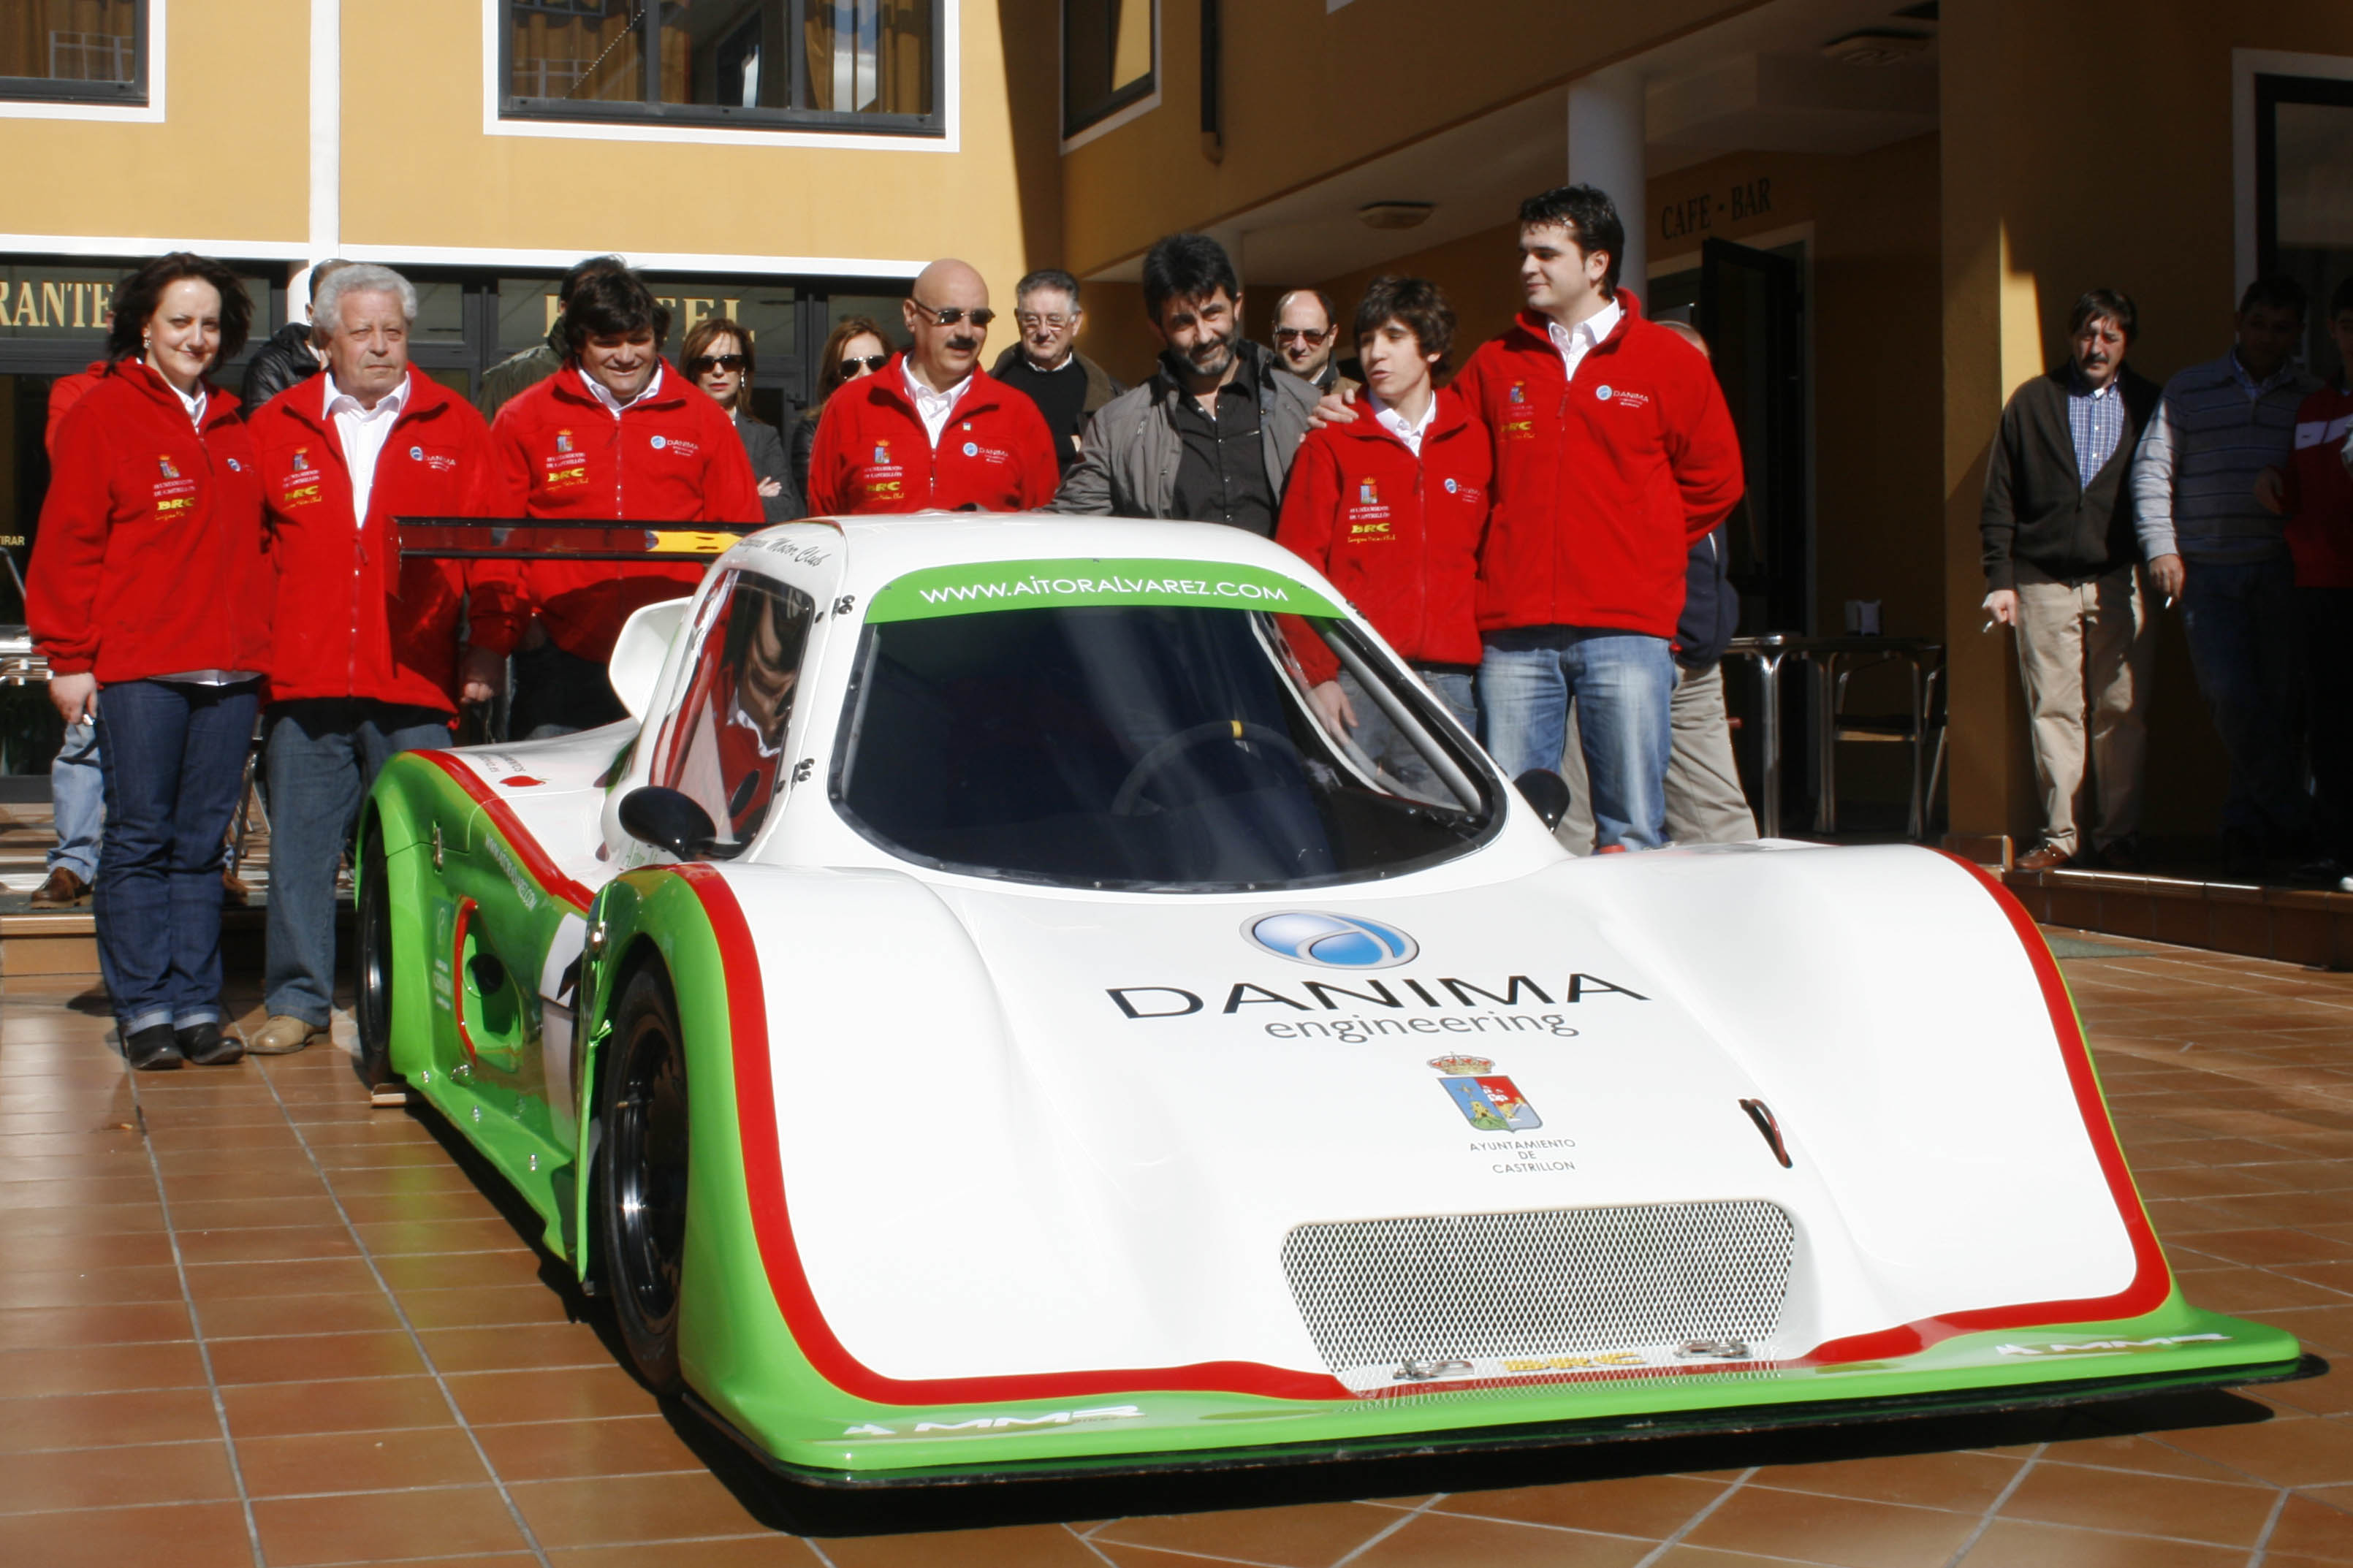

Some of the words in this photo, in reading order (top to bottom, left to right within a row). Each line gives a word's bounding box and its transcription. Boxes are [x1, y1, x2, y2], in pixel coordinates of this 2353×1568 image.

[1662, 194, 1711, 240] CAFE
[1730, 178, 1772, 222] BAR
[547, 468, 585, 482] BRC
[156, 497, 195, 511] BRC
[1350, 522, 1391, 534] BRC
[794, 546, 832, 567] Club
[1105, 973, 1653, 1019] DANIMA
[1264, 1011, 1580, 1044] engineering
[1469, 1138, 1576, 1152] AYUNTAMIENTO
[1517, 1150, 1537, 1160] DE
[1491, 1161, 1577, 1174] CASTRILLON
